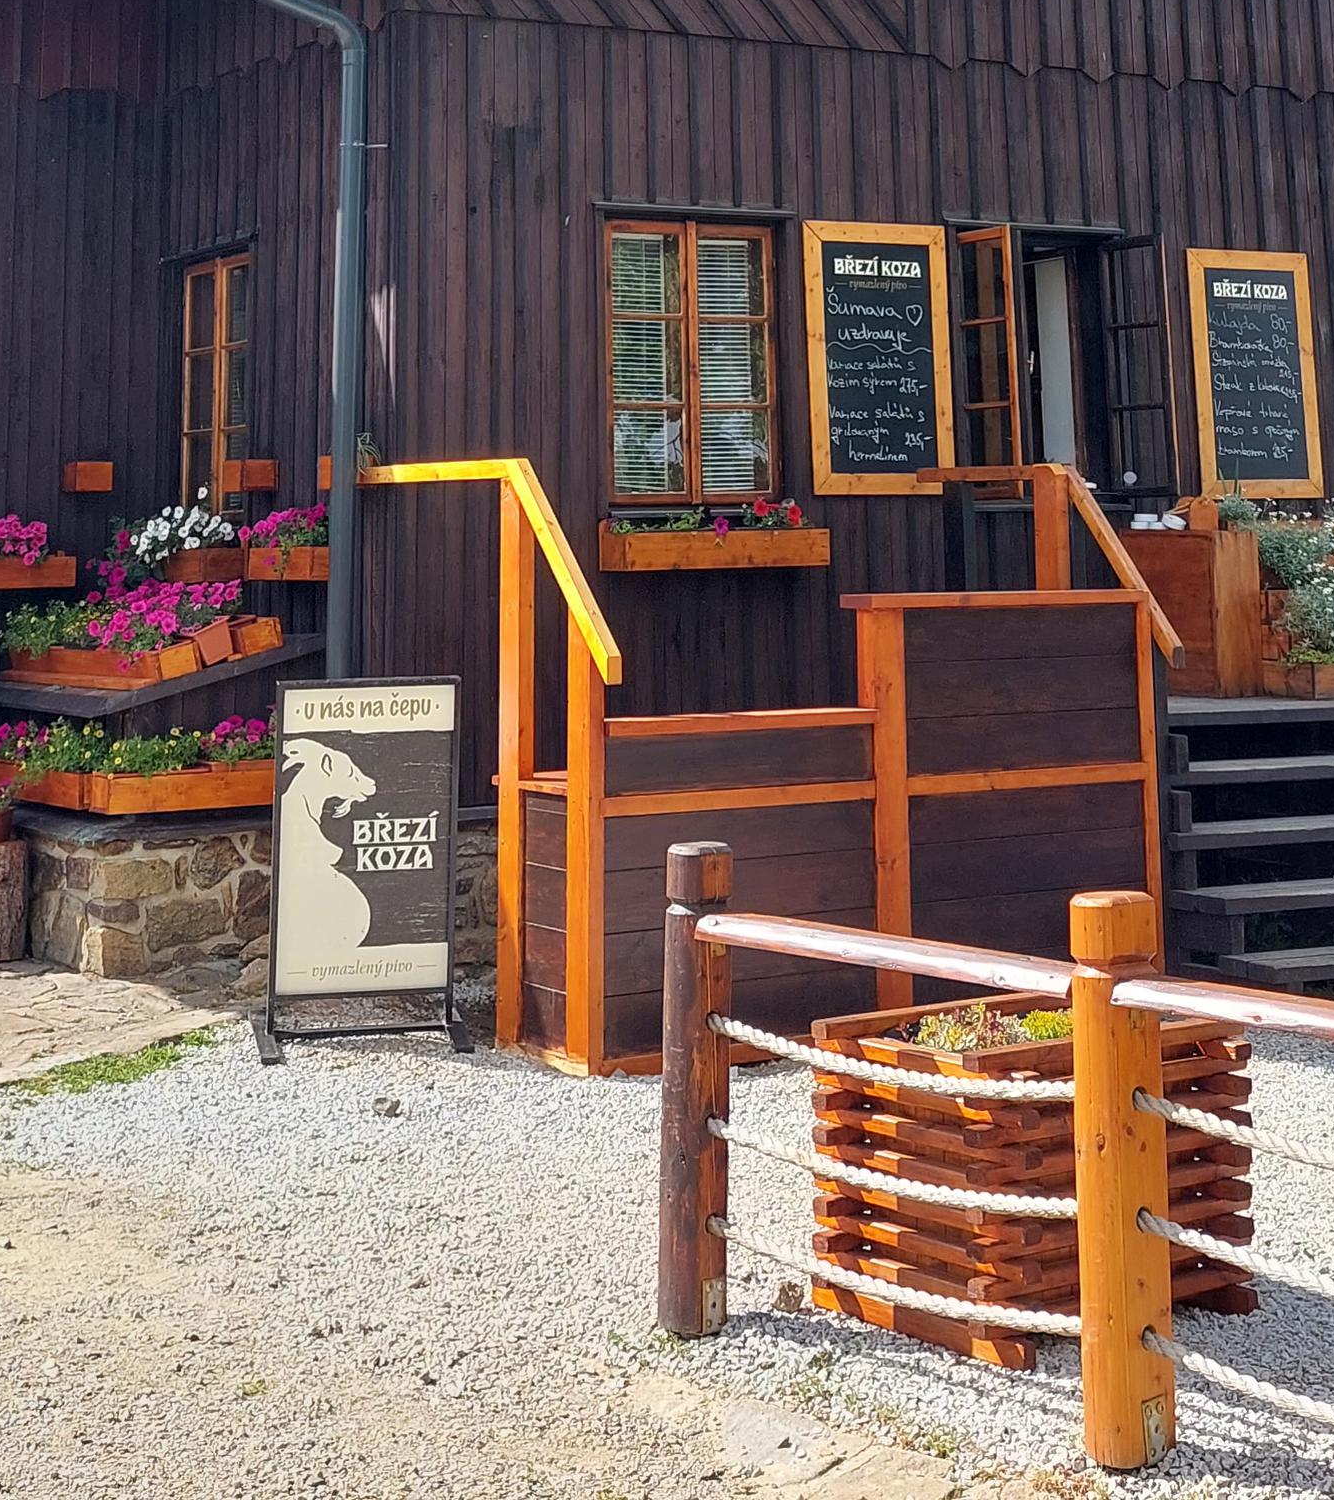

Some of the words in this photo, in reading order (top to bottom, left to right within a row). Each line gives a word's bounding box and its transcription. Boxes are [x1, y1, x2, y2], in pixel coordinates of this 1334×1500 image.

[833, 254, 879, 277] BŘEZÍ
[881, 260, 922, 278] KOZA
[1212, 278, 1252, 299] BŘEZÍ
[1253, 283, 1288, 300] KOZA
[825, 286, 904, 320] Šumava
[837, 322, 913, 350] uzdravuje
[906, 360, 917, 372] s
[916, 409, 926, 423] s
[1251, 425, 1259, 435] s
[303, 702, 315, 721] u
[319, 694, 356, 720] nás
[359, 699, 385, 719] na
[389, 691, 432, 722] čepu
[351, 809, 440, 845] BŘEZÍ
[355, 843, 434, 872] KOZA
[311, 959, 384, 981] vymazlený
[384, 958, 414, 978] pivo
